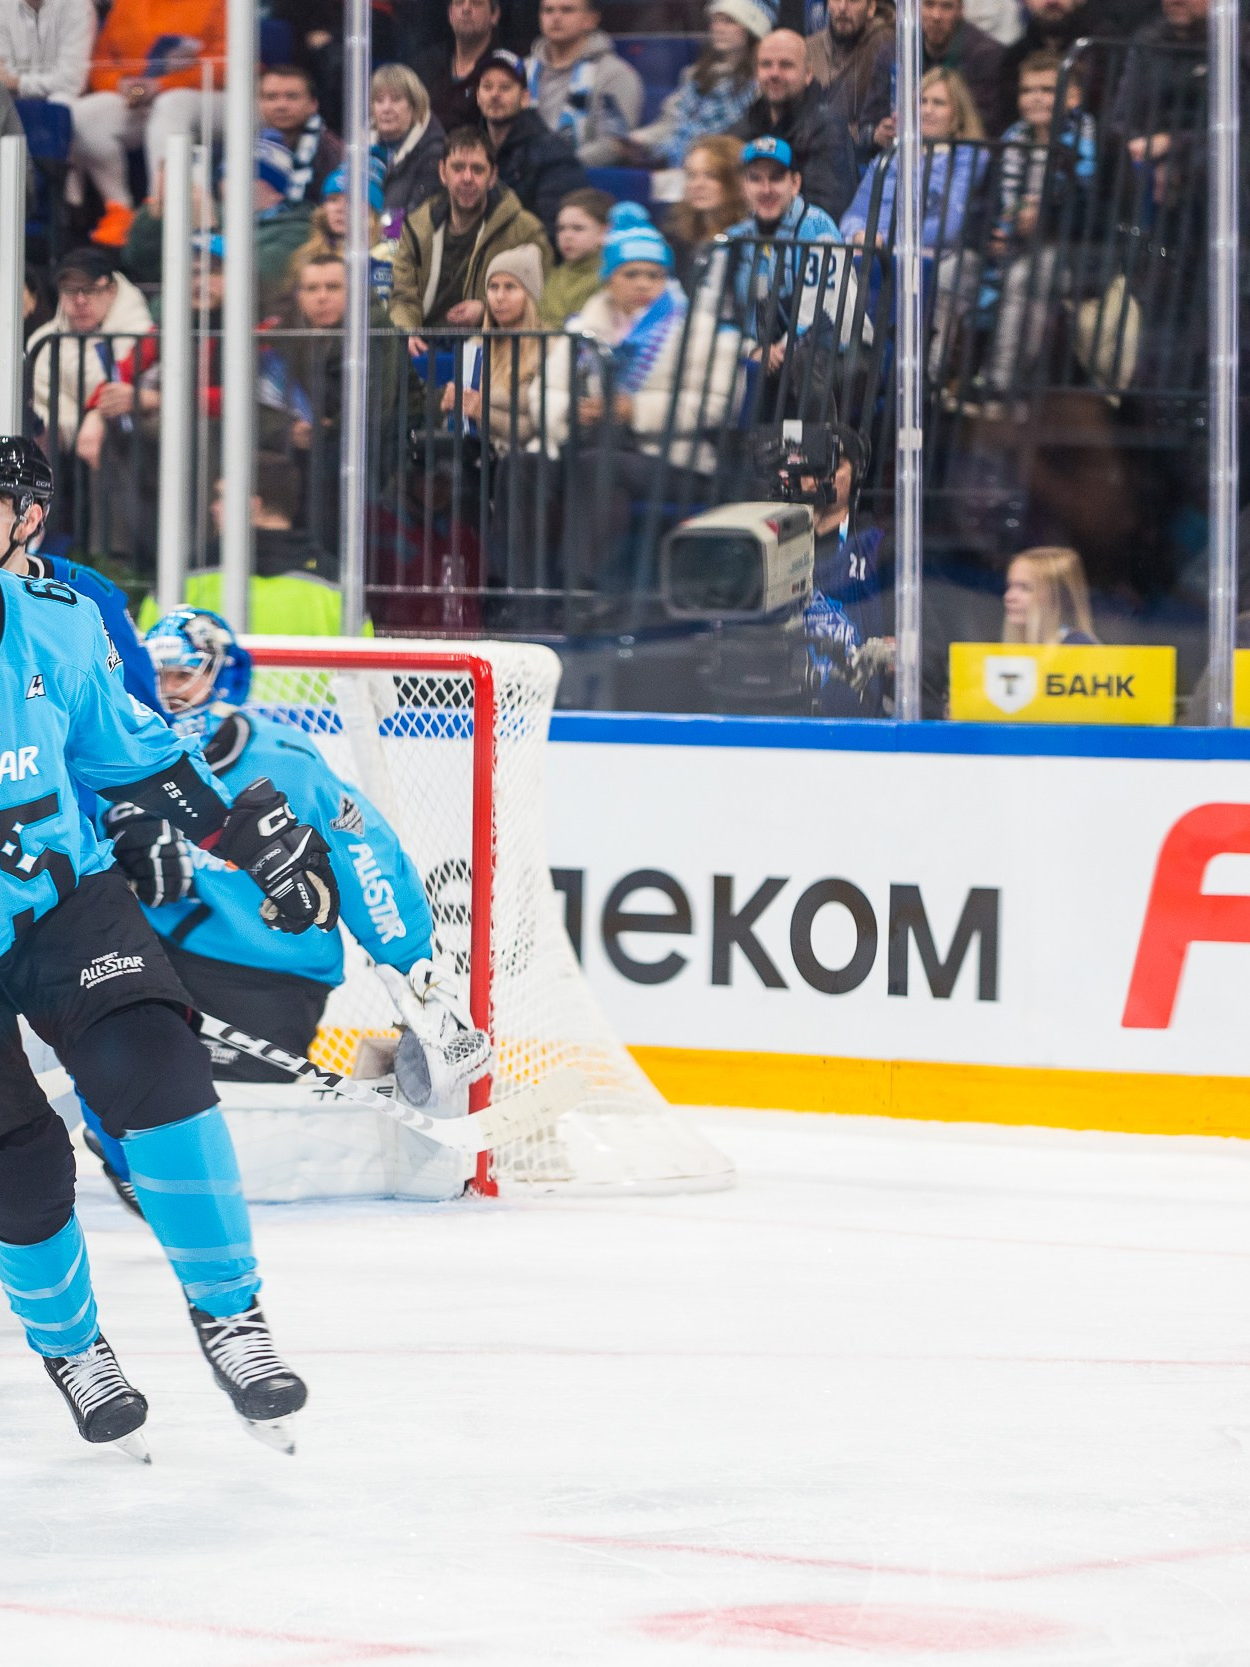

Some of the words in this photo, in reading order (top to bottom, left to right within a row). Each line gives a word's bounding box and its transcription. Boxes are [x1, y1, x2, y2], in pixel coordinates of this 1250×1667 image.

[1045, 674, 1136, 698] БАНК
[161, 781, 183, 799] 25
[296, 882, 312, 909] CCM
[219, 1024, 344, 1088] CCM
